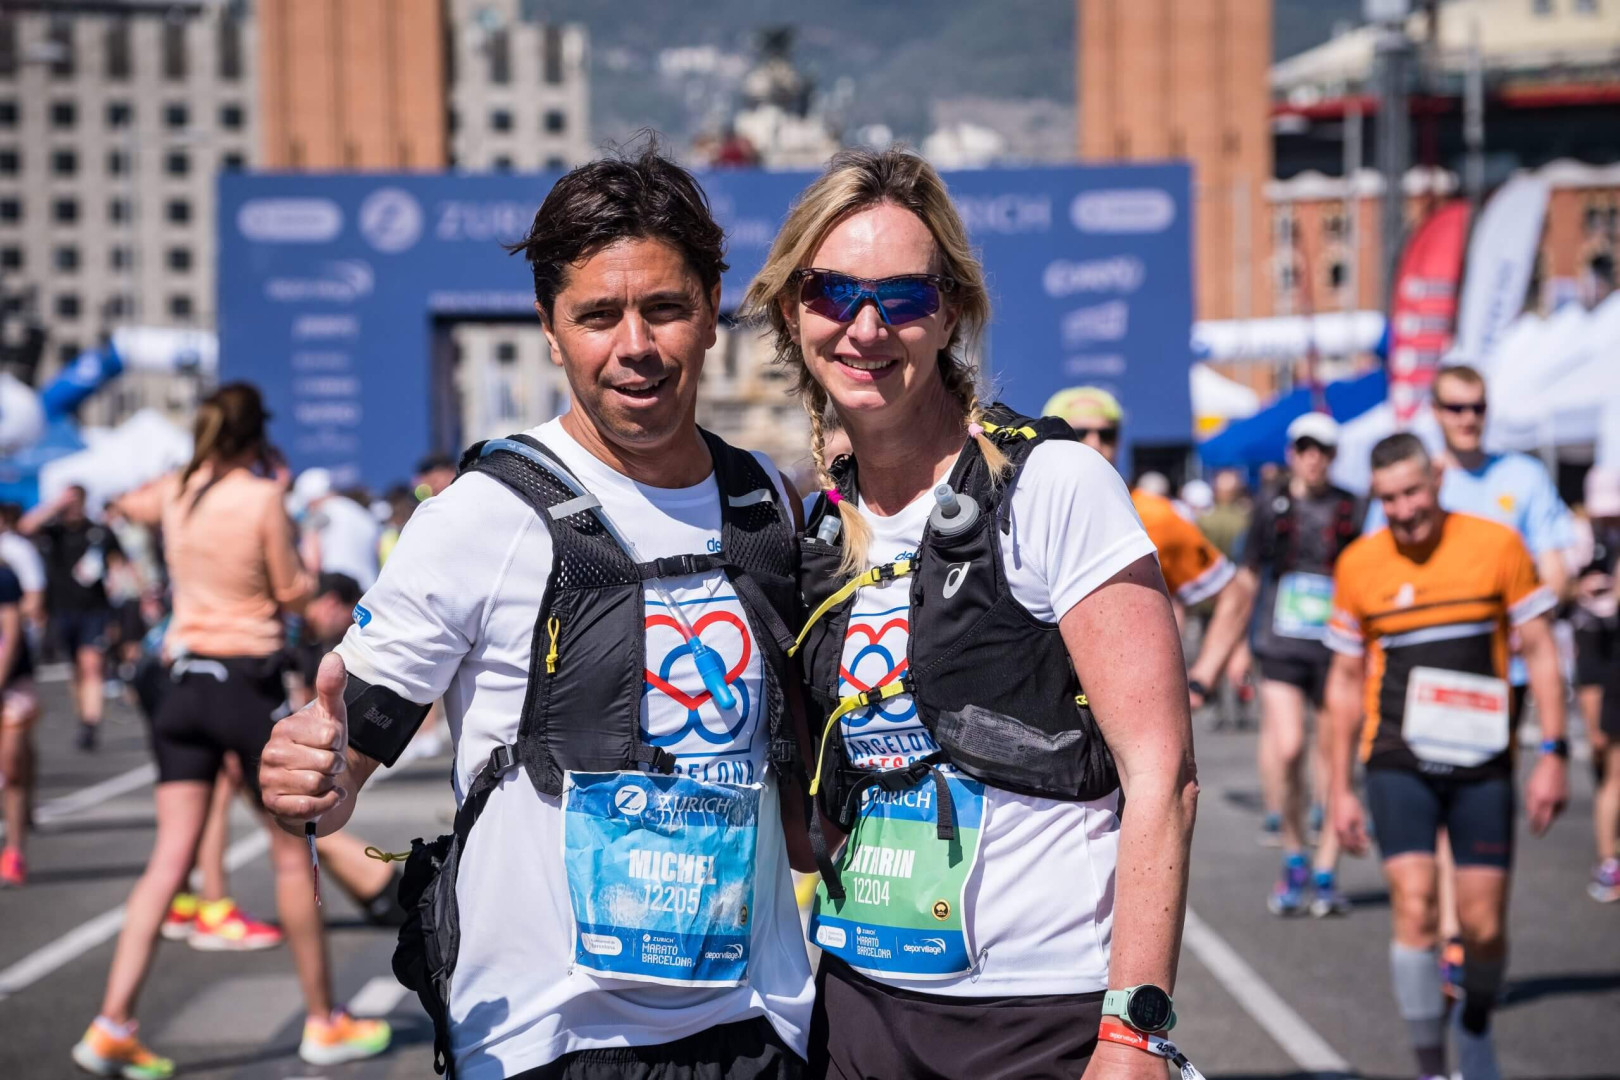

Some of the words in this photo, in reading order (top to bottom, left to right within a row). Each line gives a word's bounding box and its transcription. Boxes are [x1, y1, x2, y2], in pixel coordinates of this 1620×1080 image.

[628, 849, 717, 885] MICHEL
[644, 883, 702, 915] 12205
[853, 876, 890, 907] 12204
[642, 942, 678, 956] MARATÓ
[704, 950, 739, 960] deporvillage
[856, 944, 892, 959] BARCELONA
[903, 943, 942, 956] deporvillage
[641, 953, 693, 968] BARCELONA
